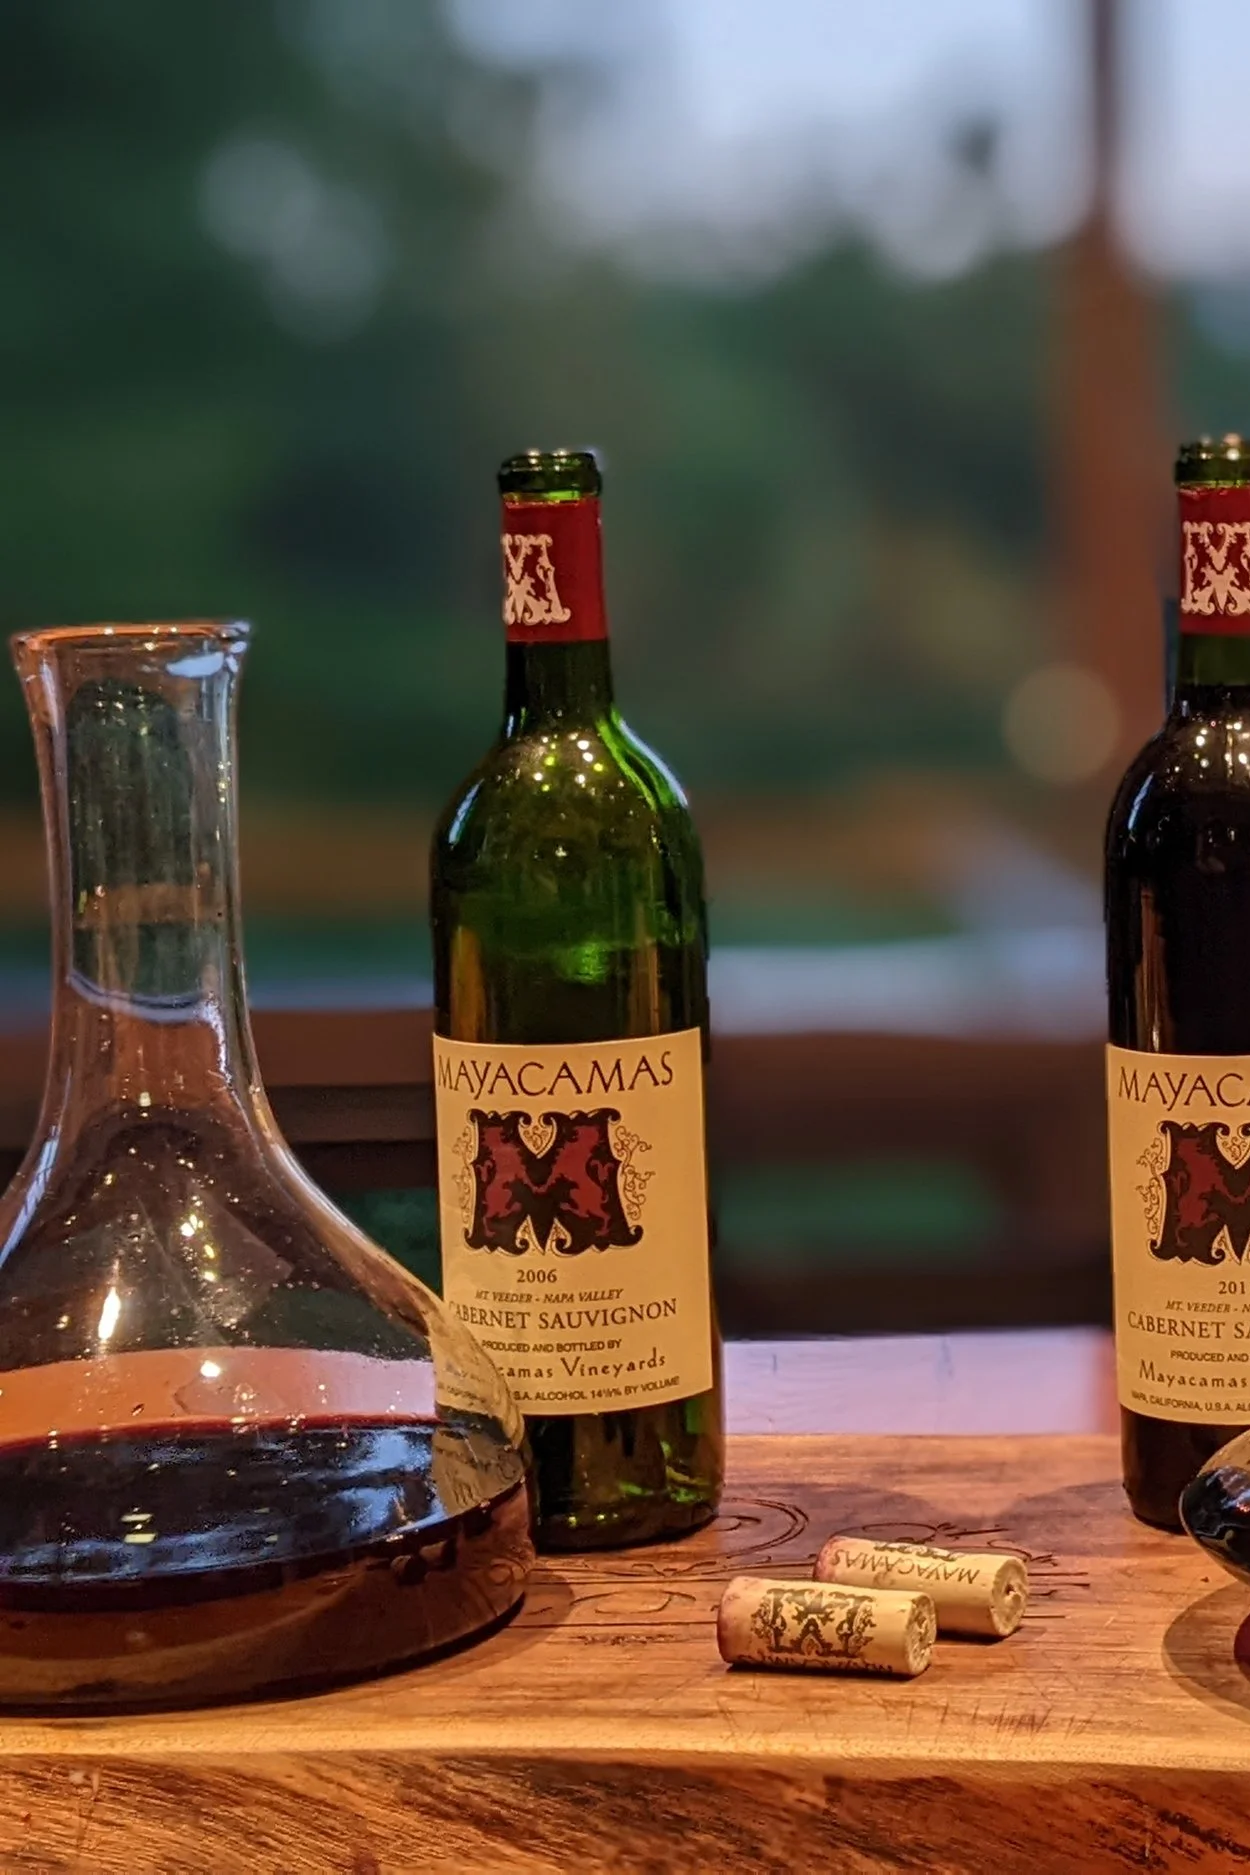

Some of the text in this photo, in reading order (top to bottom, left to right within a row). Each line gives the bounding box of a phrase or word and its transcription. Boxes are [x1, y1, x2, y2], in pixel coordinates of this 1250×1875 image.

[438, 1051, 674, 1100] MAYACAMAS
[516, 1268, 558, 1284] 2006
[492, 1290, 534, 1304] VEEDER
[543, 1293, 575, 1304] NAPA
[579, 1288, 624, 1302] VALLEY
[1187, 1302, 1231, 1314] VEEDER
[538, 1298, 677, 1330] SAUVIGNON
[1127, 1310, 1226, 1339] CABERNET
[481, 1339, 622, 1353] PRODUCED AND BOTTLED BY
[1170, 1350, 1225, 1363] PRODUCED
[1227, 1352, 1250, 1363] AND
[559, 1347, 666, 1379] Vineyards
[1139, 1359, 1248, 1388] Mayacamas
[624, 1384, 638, 1395] BY
[641, 1376, 680, 1392] VOLUME
[830, 1548, 981, 1585] MAYACAMAS
